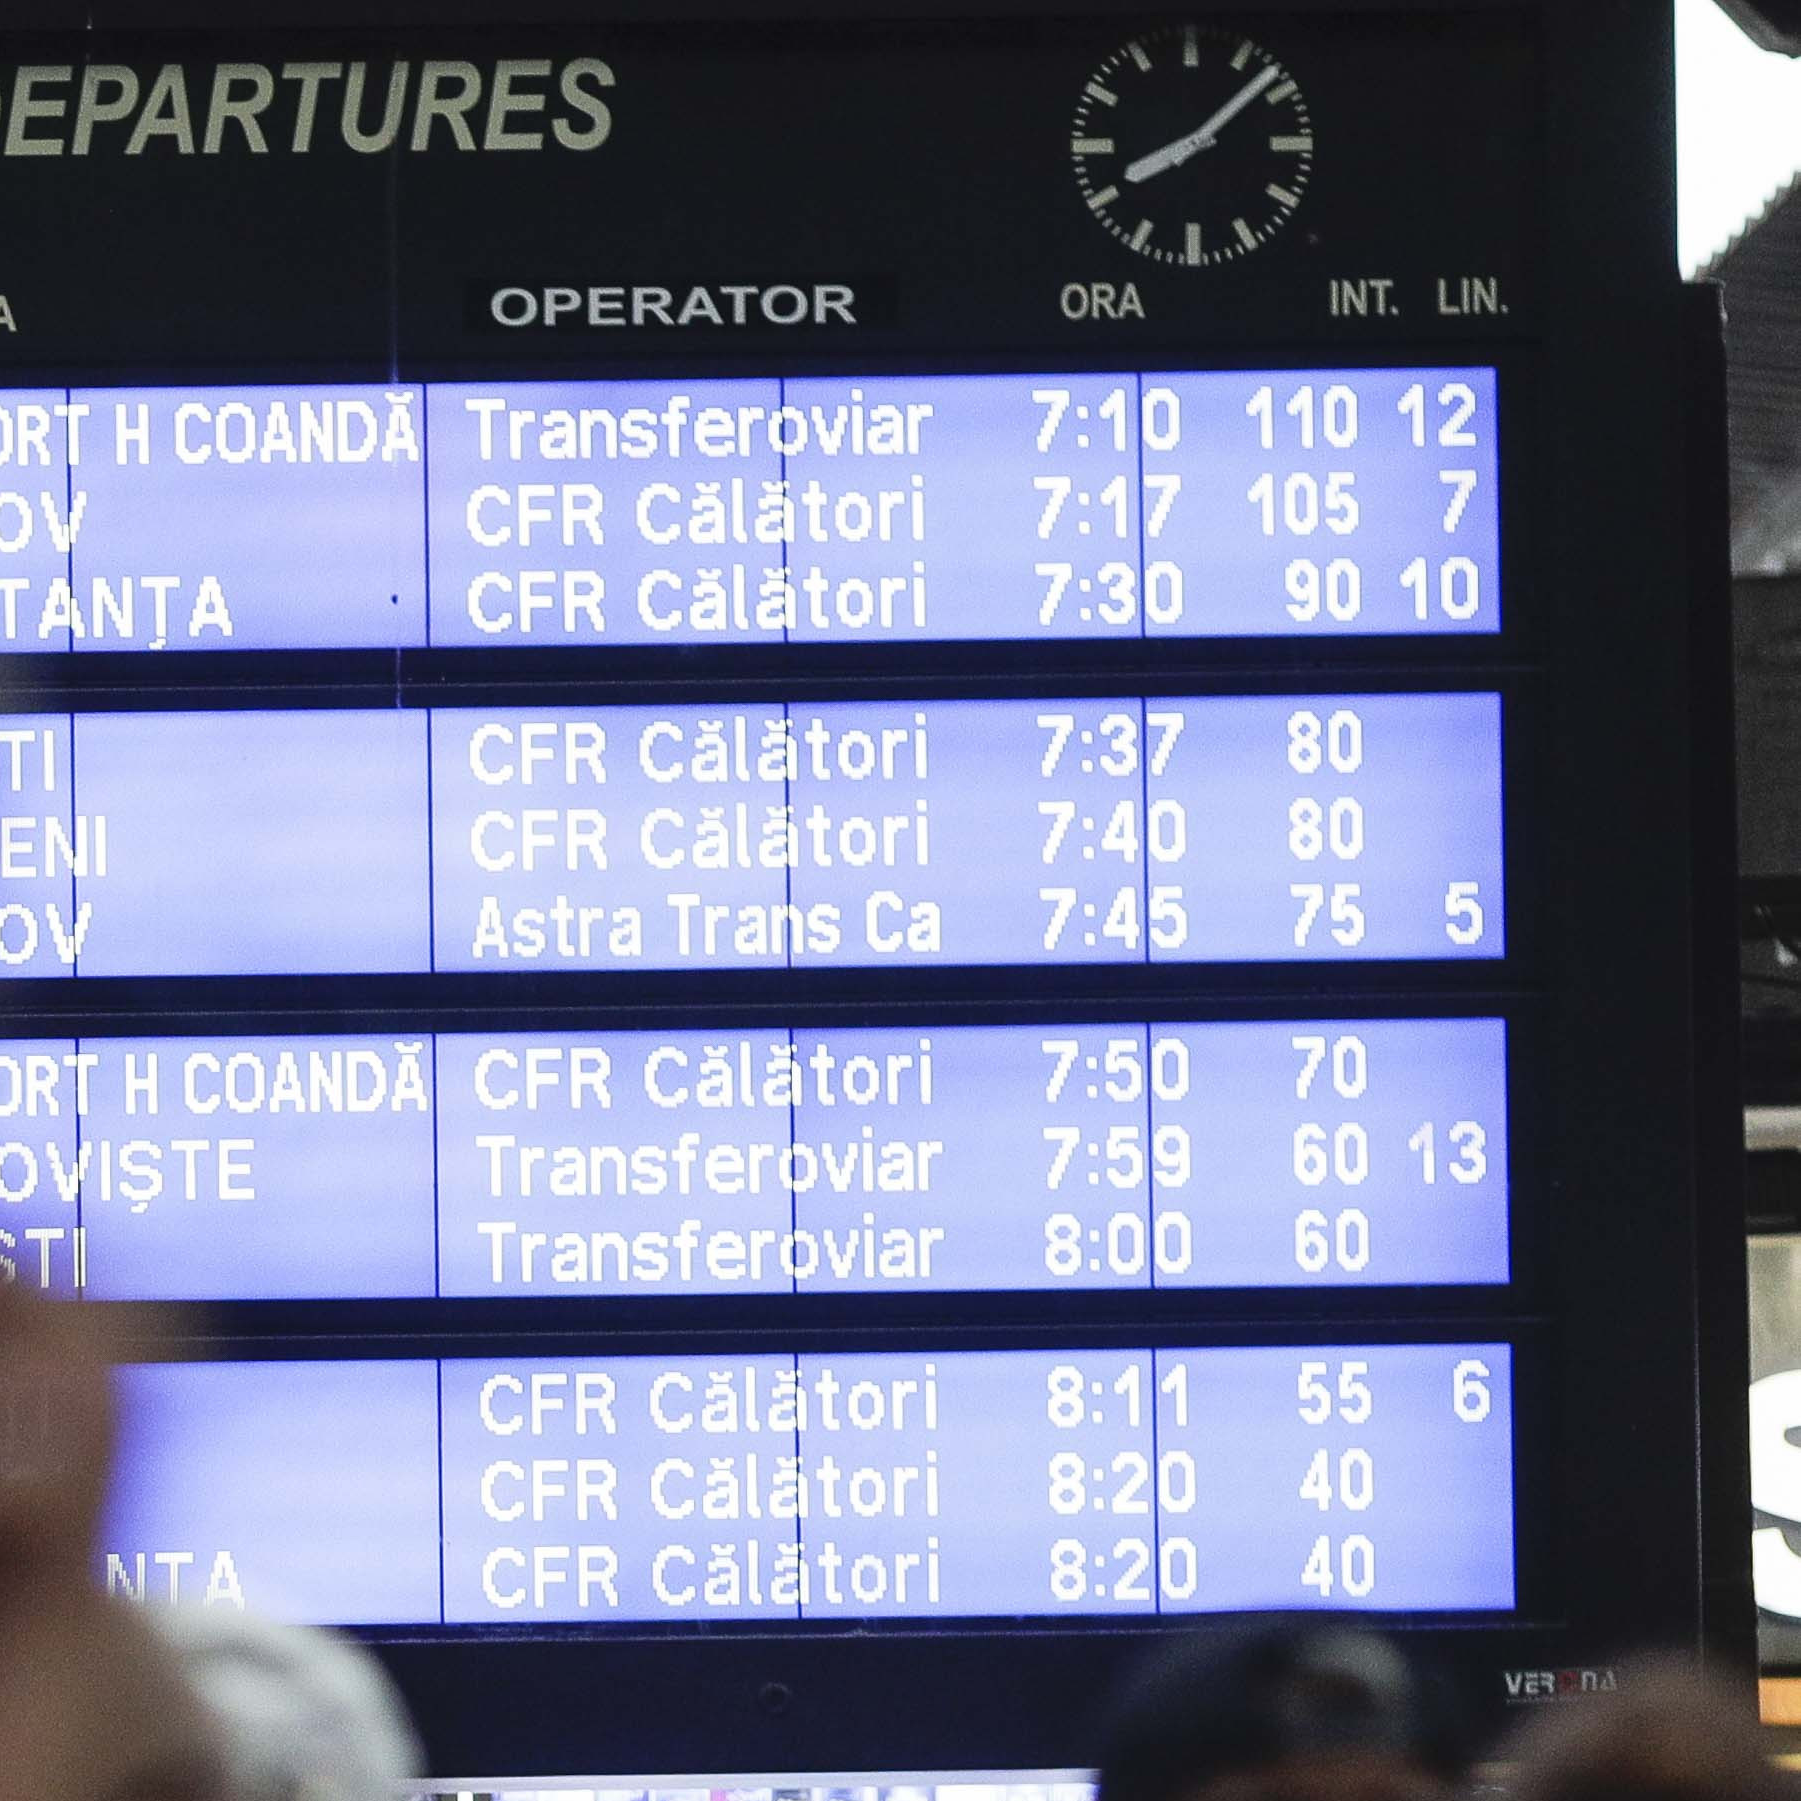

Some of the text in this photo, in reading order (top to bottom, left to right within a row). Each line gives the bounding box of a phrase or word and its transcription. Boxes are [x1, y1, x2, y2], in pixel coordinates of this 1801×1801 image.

[491, 285, 856, 327] OPERATOR
[1061, 283, 1145, 320] ORA
[1330, 279, 1399, 316] INT.
[1438, 278, 1508, 315] LIN.
[116, 404, 149, 464] H
[176, 392, 418, 464] COANDĂ
[466, 390, 932, 459] Transferoviar
[1033, 389, 1179, 451] 7:10
[1246, 386, 1357, 448] 110
[1399, 385, 1475, 445] 12
[467, 484, 603, 546] CFR
[637, 475, 923, 544] Călători
[1034, 475, 1180, 538] 7:17
[1248, 472, 1358, 535] 105
[1441, 471, 1475, 532] 7
[1036, 562, 1182, 624] 7:30
[1286, 559, 1359, 621] 90
[1401, 558, 1478, 618] 10
[1039, 800, 1185, 863] 7:40
[1290, 798, 1362, 859] 80
[473, 896, 641, 957] Astra
[668, 894, 840, 955] Trans
[867, 891, 940, 952] Ca
[1040, 886, 1186, 949] 7:45
[1291, 884, 1364, 946] 75
[1446, 883, 1482, 943] 5
[126, 1054, 157, 1114] H
[185, 1042, 427, 1113] COANDĂ
[1043, 1039, 1188, 1102] 7:50
[1293, 1037, 1366, 1098] 70
[476, 1127, 942, 1196] Transferoviar
[1044, 1126, 1190, 1189] 7:59
[1294, 1123, 1367, 1185] 60
[1410, 1122, 1485, 1183] 13
[481, 1361, 1489, 1435] CFR Călători 8:11 55 6
